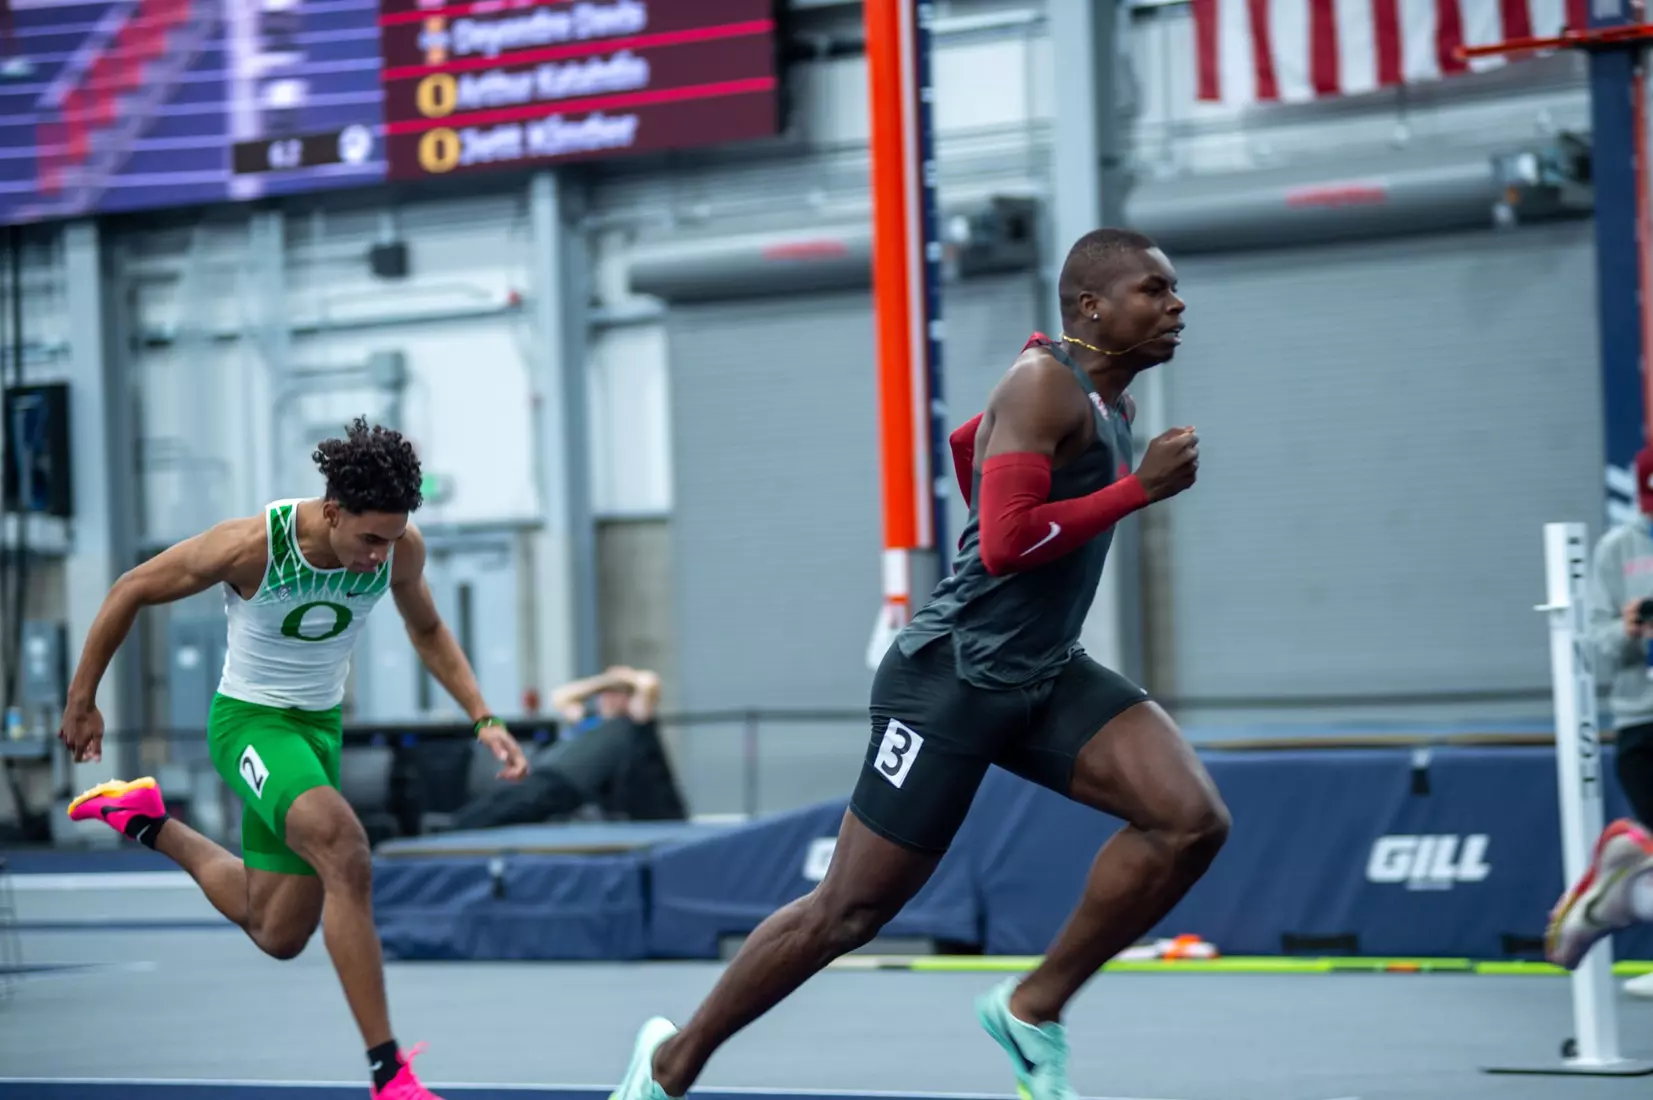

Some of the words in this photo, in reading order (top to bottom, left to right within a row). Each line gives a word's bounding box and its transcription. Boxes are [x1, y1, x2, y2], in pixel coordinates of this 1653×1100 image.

[281, 601, 353, 642] O
[242, 756, 264, 791] 2
[881, 727, 912, 776] 3
[1366, 834, 1491, 882] GILL
